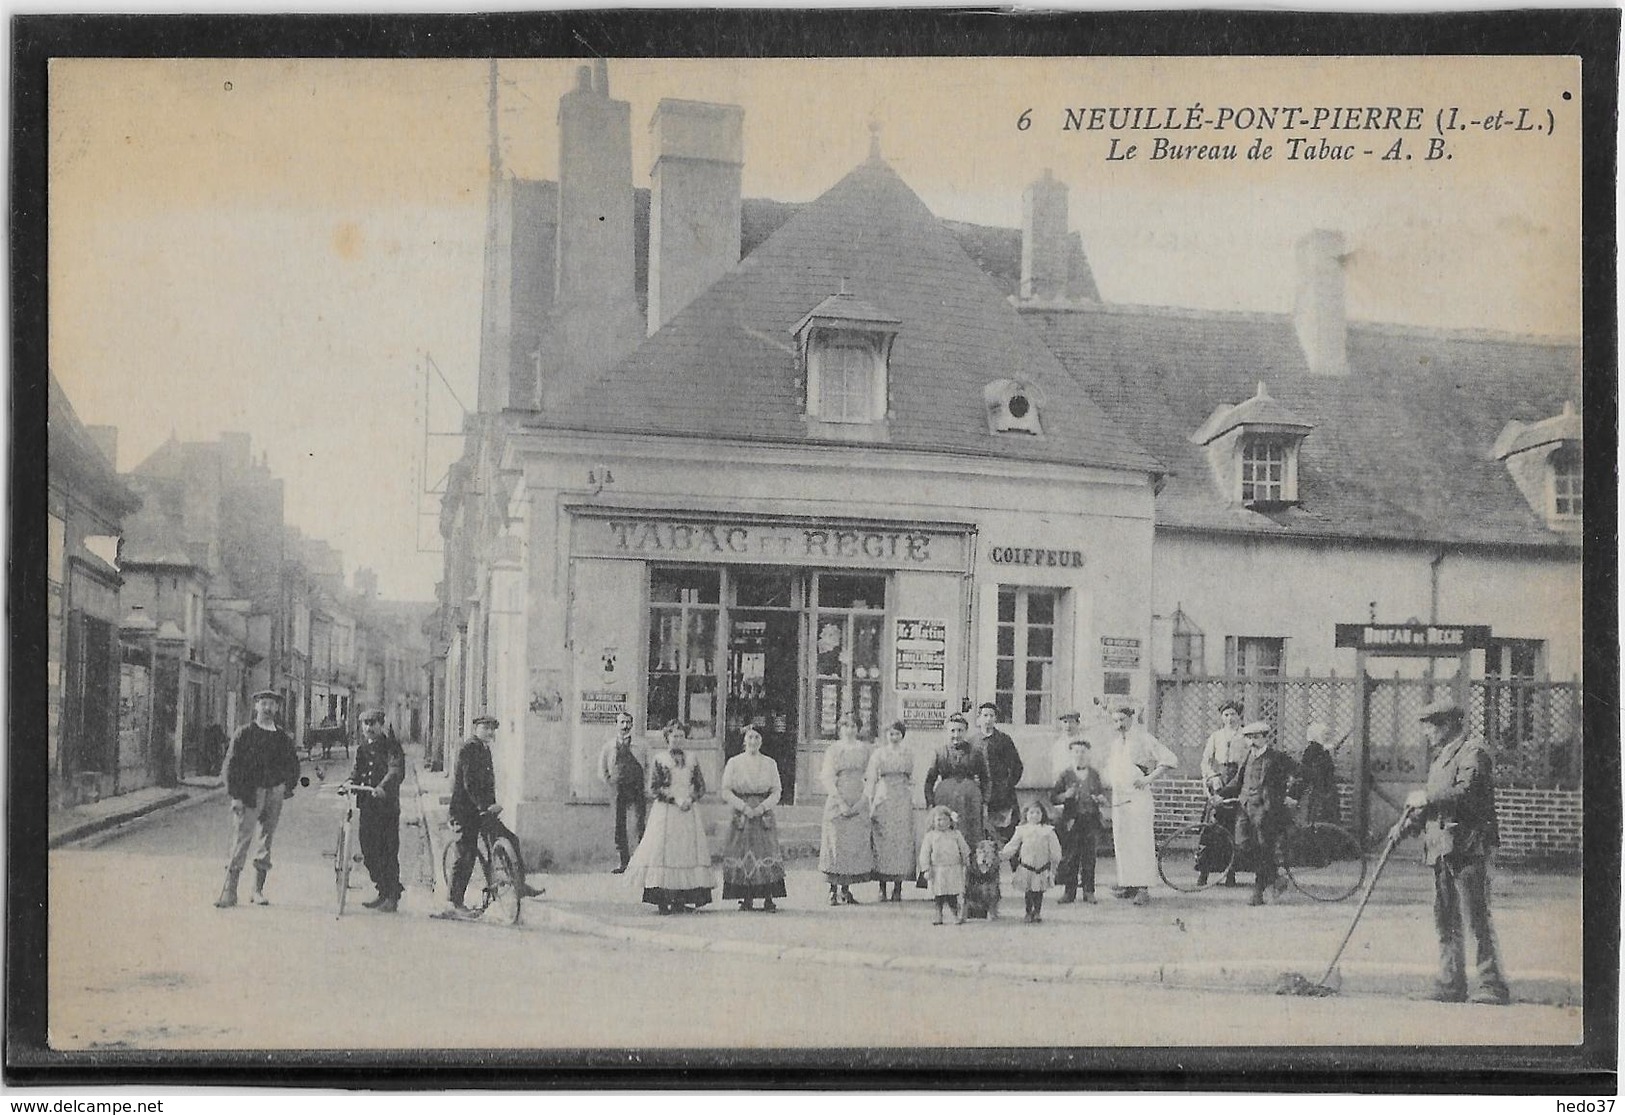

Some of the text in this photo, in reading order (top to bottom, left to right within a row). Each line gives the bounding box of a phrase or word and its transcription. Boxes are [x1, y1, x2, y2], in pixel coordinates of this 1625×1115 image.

[609, 520, 748, 552] TABAC
[760, 536, 791, 550] ET
[990, 546, 1084, 568] COIFFEUR
